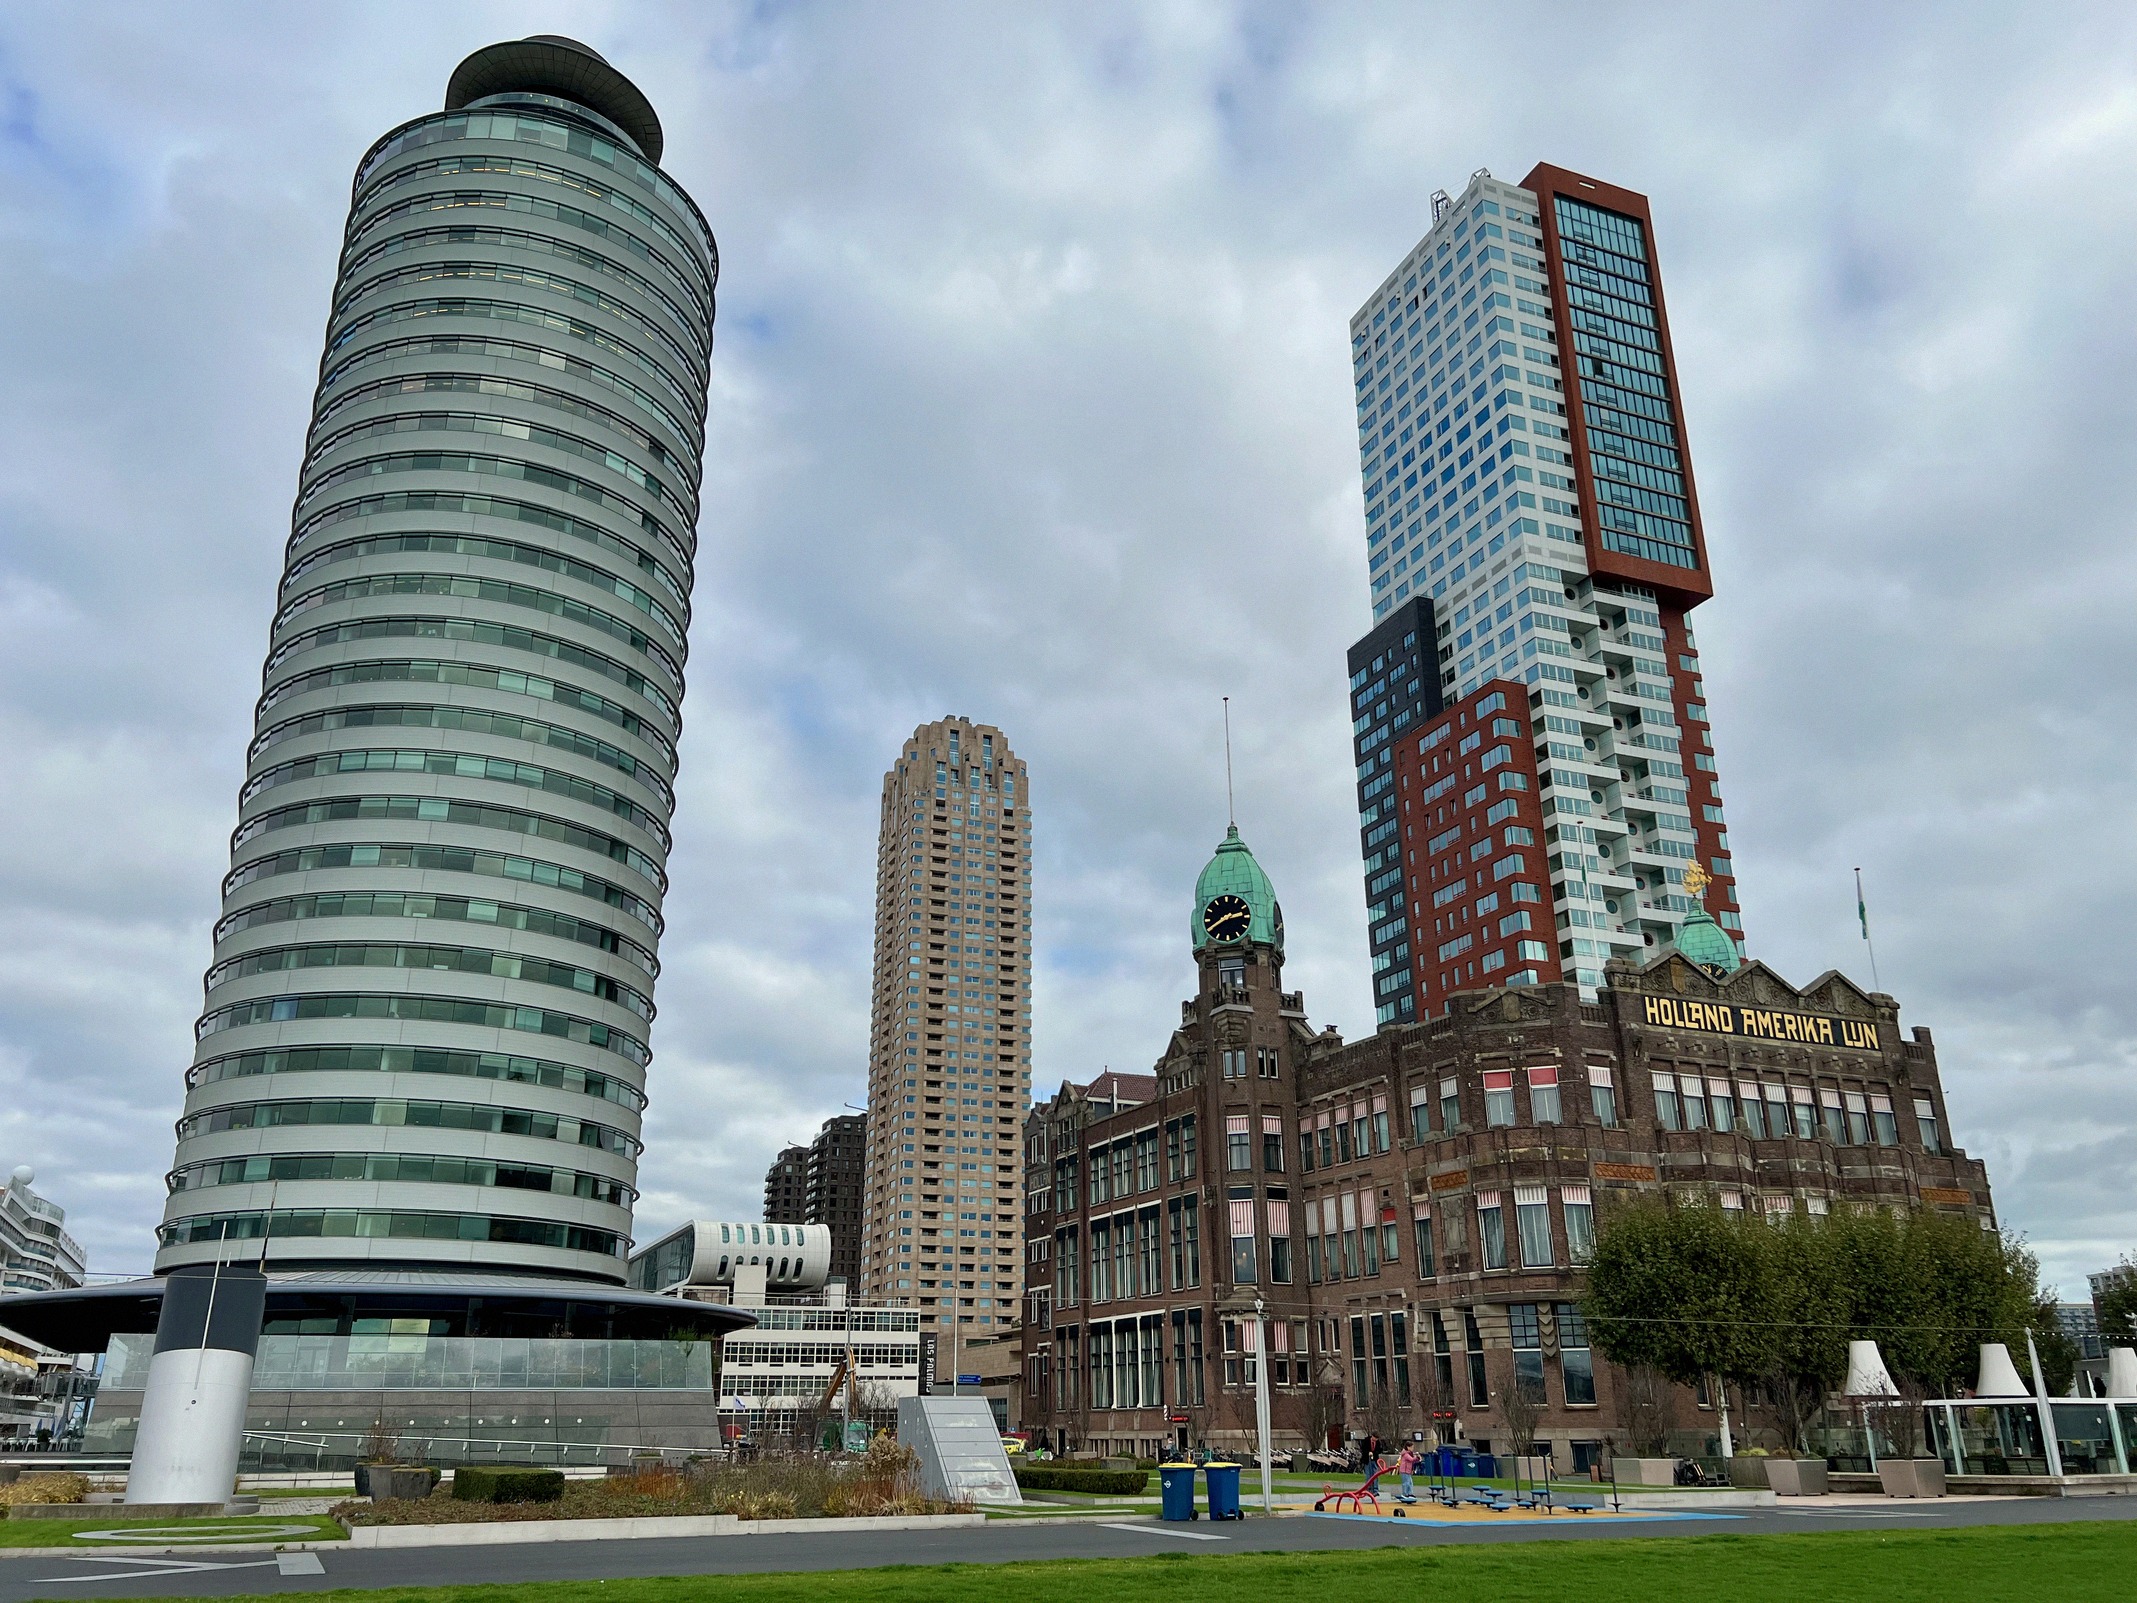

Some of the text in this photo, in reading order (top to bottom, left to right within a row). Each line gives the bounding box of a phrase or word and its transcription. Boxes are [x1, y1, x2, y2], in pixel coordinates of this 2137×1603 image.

[1644, 996, 1733, 1033] HOLLAND
[1740, 1008, 1834, 1045] AMERIKA
[927, 1339, 935, 1355] LAS
